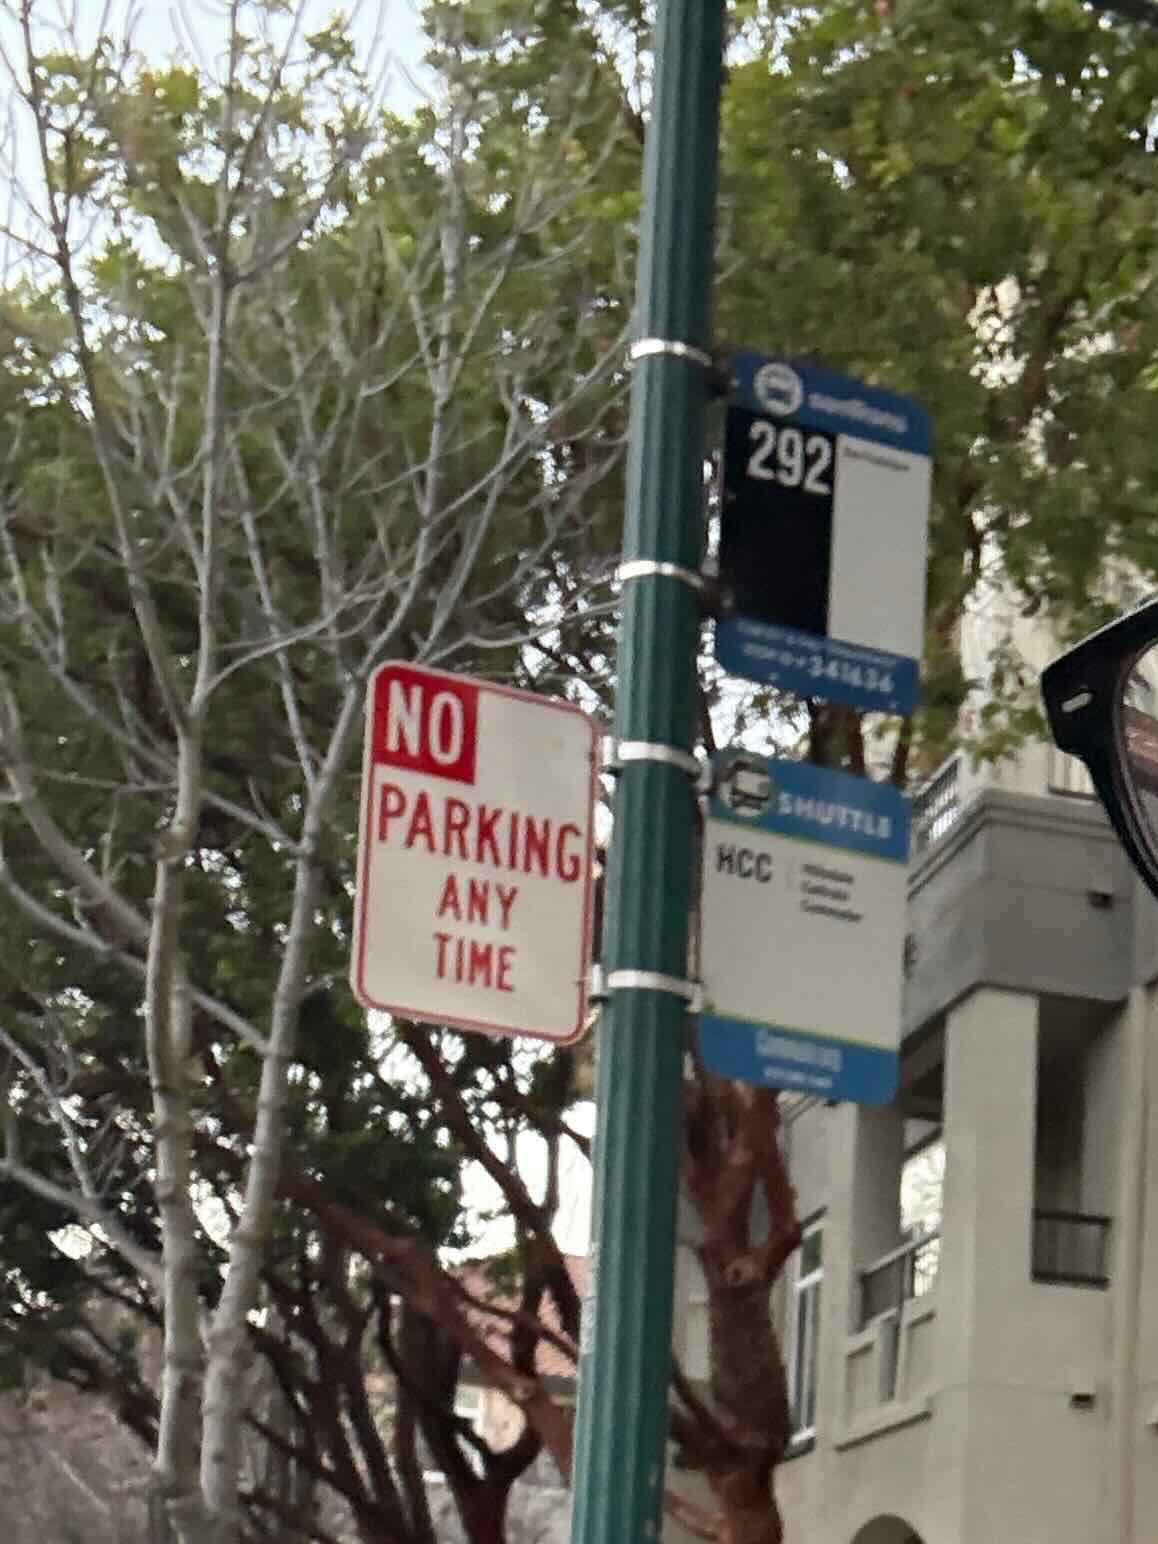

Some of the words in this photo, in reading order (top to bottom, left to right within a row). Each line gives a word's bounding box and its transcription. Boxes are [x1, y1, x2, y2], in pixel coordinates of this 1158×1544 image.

[747, 420, 833, 495] 292
[386, 678, 465, 767] NO
[378, 782, 583, 883] PARKING
[777, 790, 893, 840] SHUTTLE
[437, 874, 518, 931] ANY
[433, 931, 517, 993] TIME
